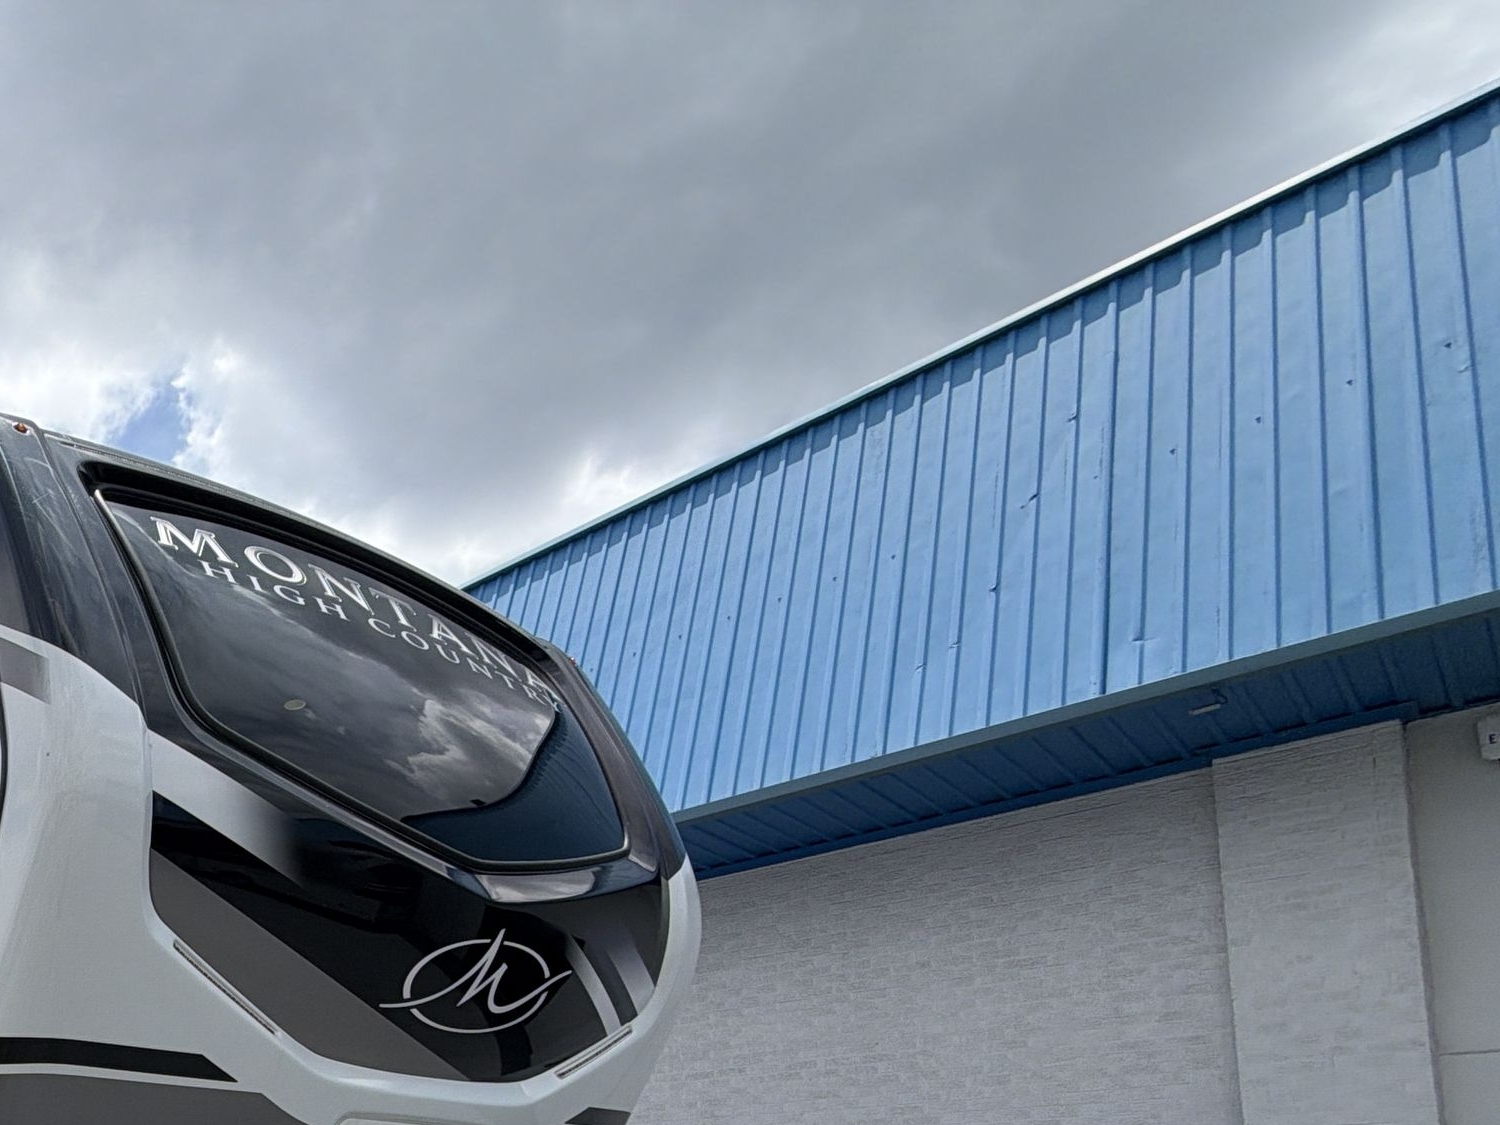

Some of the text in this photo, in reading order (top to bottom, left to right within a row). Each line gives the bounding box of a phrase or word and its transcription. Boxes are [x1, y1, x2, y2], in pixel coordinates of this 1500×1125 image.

[150, 517, 567, 707] MONTANA
[200, 560, 562, 713] HIGH COUNTRY
